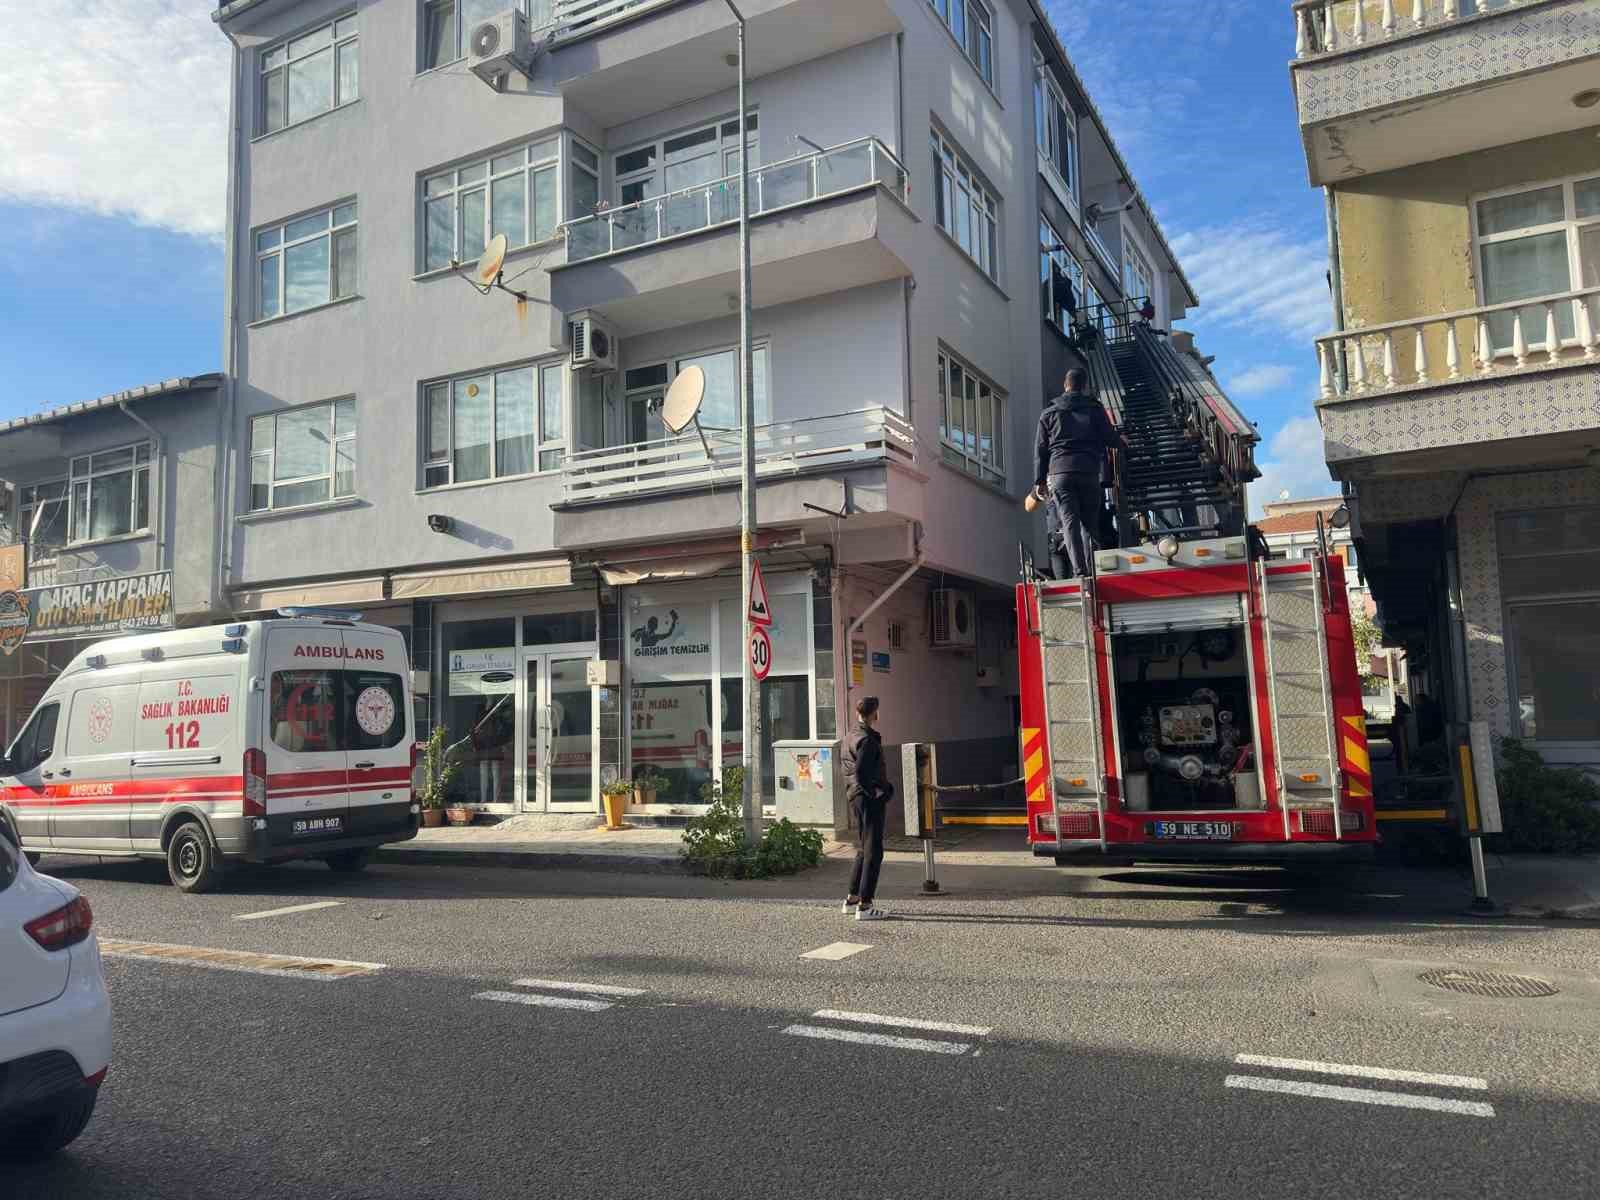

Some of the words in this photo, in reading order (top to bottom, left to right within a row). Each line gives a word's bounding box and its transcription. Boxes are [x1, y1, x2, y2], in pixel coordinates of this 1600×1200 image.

[95, 573, 171, 609] KAPLAMA
[37, 604, 63, 628] OTO
[65, 602, 97, 625] CAM
[294, 645, 385, 661] AMBULANS
[752, 639, 767, 666] 30
[178, 680, 193, 697] T.C.
[177, 694, 230, 717] BAKANLIĞI
[165, 720, 200, 750] 112
[1161, 823, 1177, 835] 59
[1183, 823, 1199, 835] NE
[1206, 823, 1228, 835] 510
